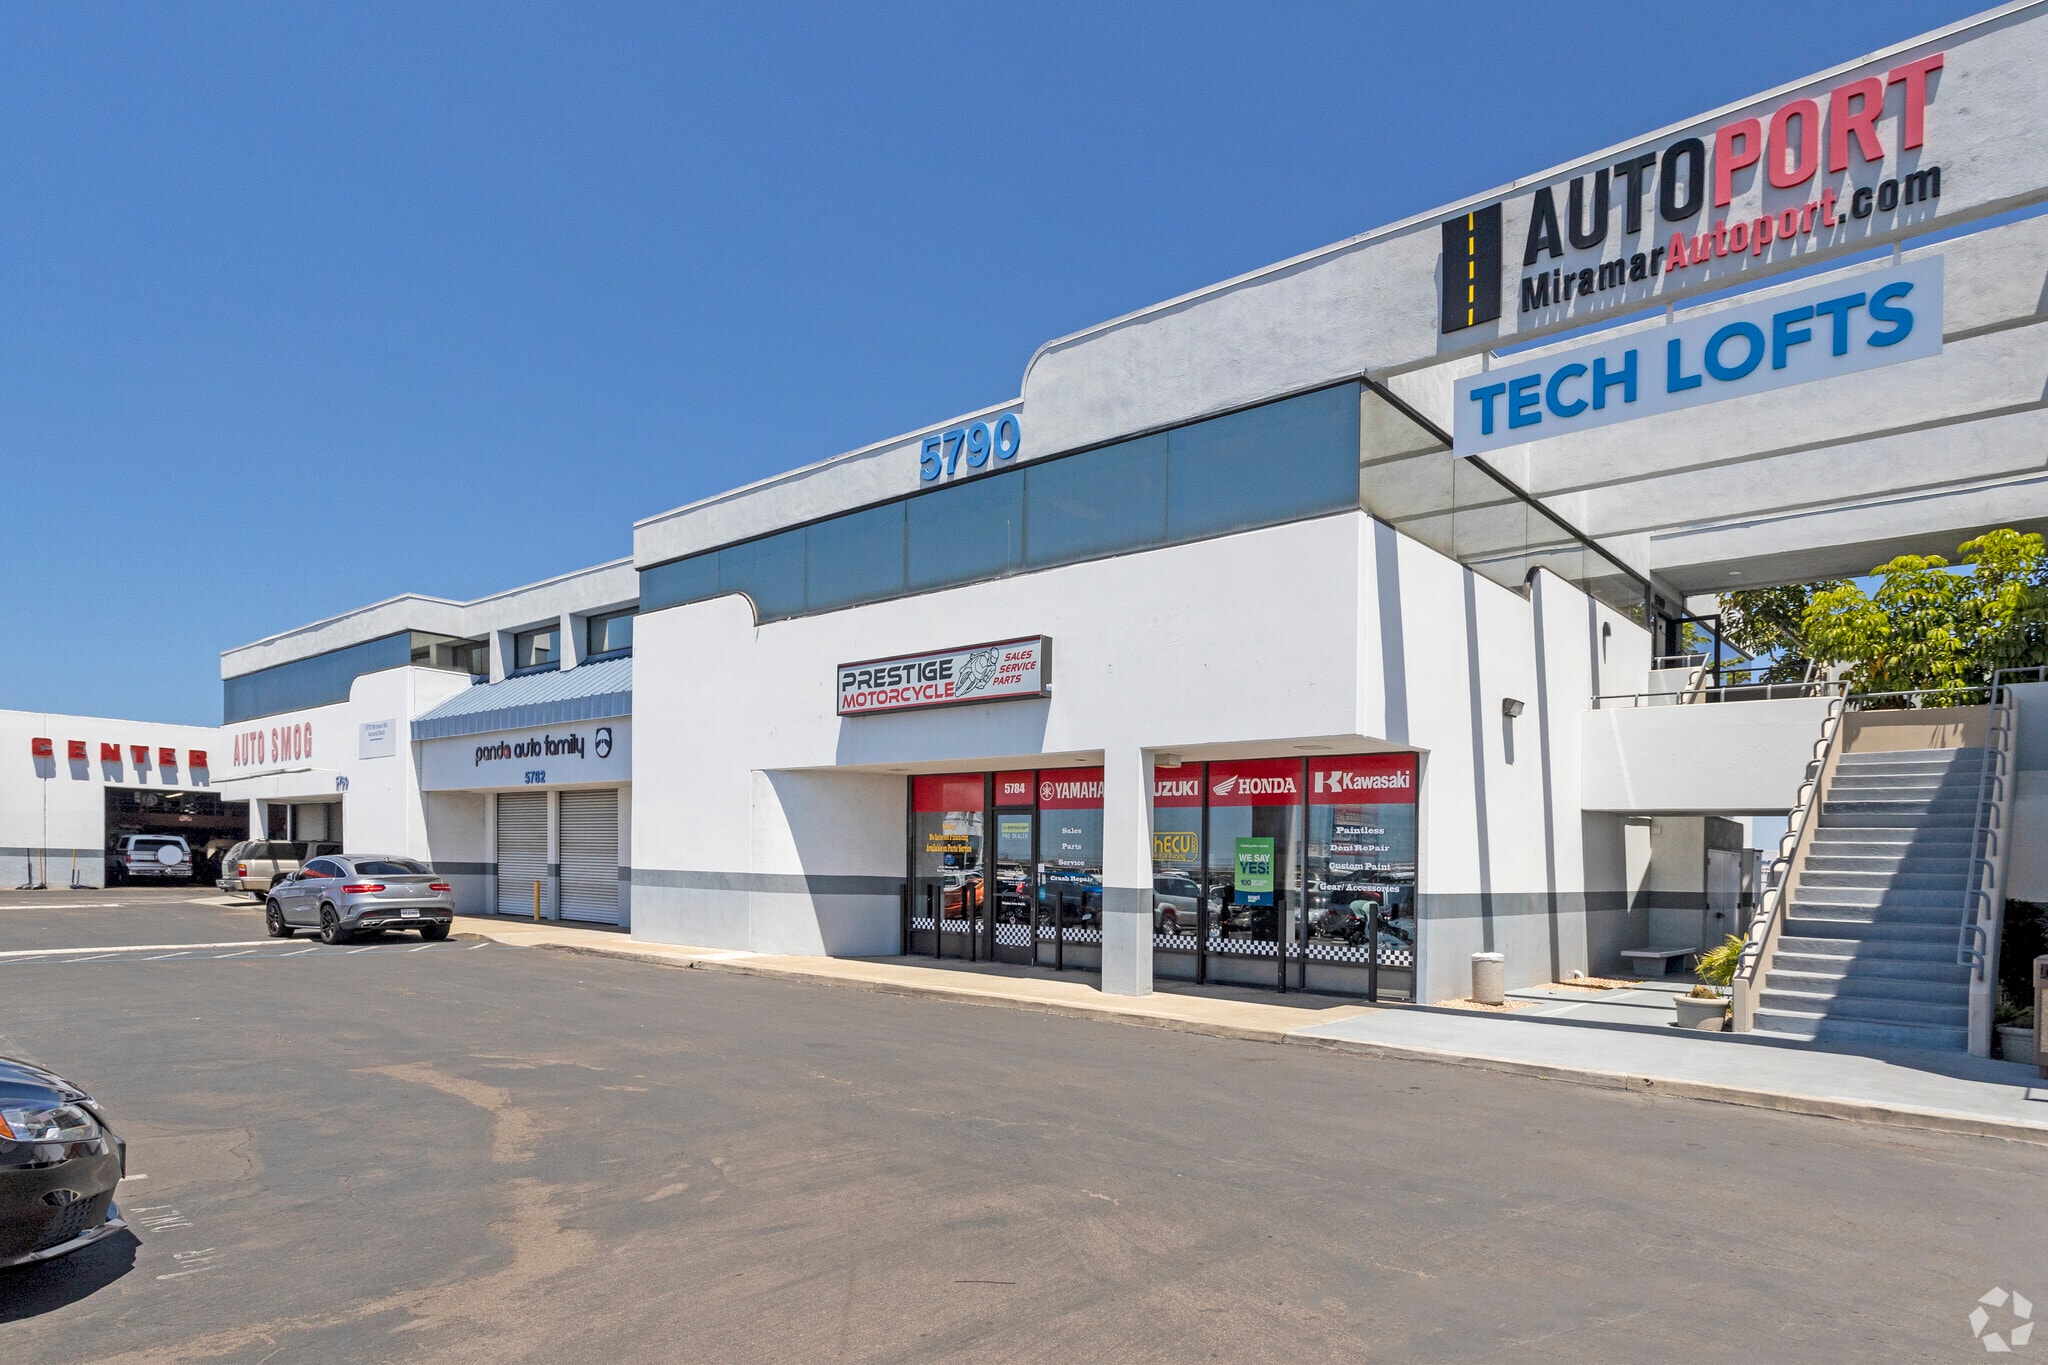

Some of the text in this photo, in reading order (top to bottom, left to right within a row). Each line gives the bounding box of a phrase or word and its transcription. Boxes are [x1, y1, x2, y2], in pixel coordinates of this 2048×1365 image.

[1522, 53, 1944, 267] AUTOPORT
[1521, 166, 1942, 313] MiramarAutoport.com
[1470, 281, 1914, 435] TECH LOFTS
[920, 412, 1021, 481] 5790
[1004, 650, 1033, 662] SALES
[842, 658, 954, 692] PRESTIGE
[999, 661, 1036, 674] SERVICE
[993, 674, 1021, 686] PARTS
[842, 681, 955, 709] MOTORCYCLE
[233, 721, 313, 767] AUTO SMOG
[475, 733, 585, 767] panda auto family
[31, 737, 207, 769] CENTER
[524, 770, 546, 784] 5782
[1342, 770, 1410, 790] Kawasaki
[1004, 782, 1026, 794] 5784
[1055, 781, 1104, 799] YAMAHA
[1154, 780, 1199, 797] UZUKI
[1238, 777, 1297, 795] HONDA
[1061, 826, 1082, 834] Sales
[1335, 826, 1385, 835] Paintless
[1154, 835, 1190, 853] hECU
[1329, 844, 1354, 852] Dent
[1239, 854, 1270, 862] WE SAY
[1328, 862, 1392, 871] Custom Paint
[1240, 861, 1270, 875] YES!
[1320, 882, 1400, 893] Gear/ Accessories
